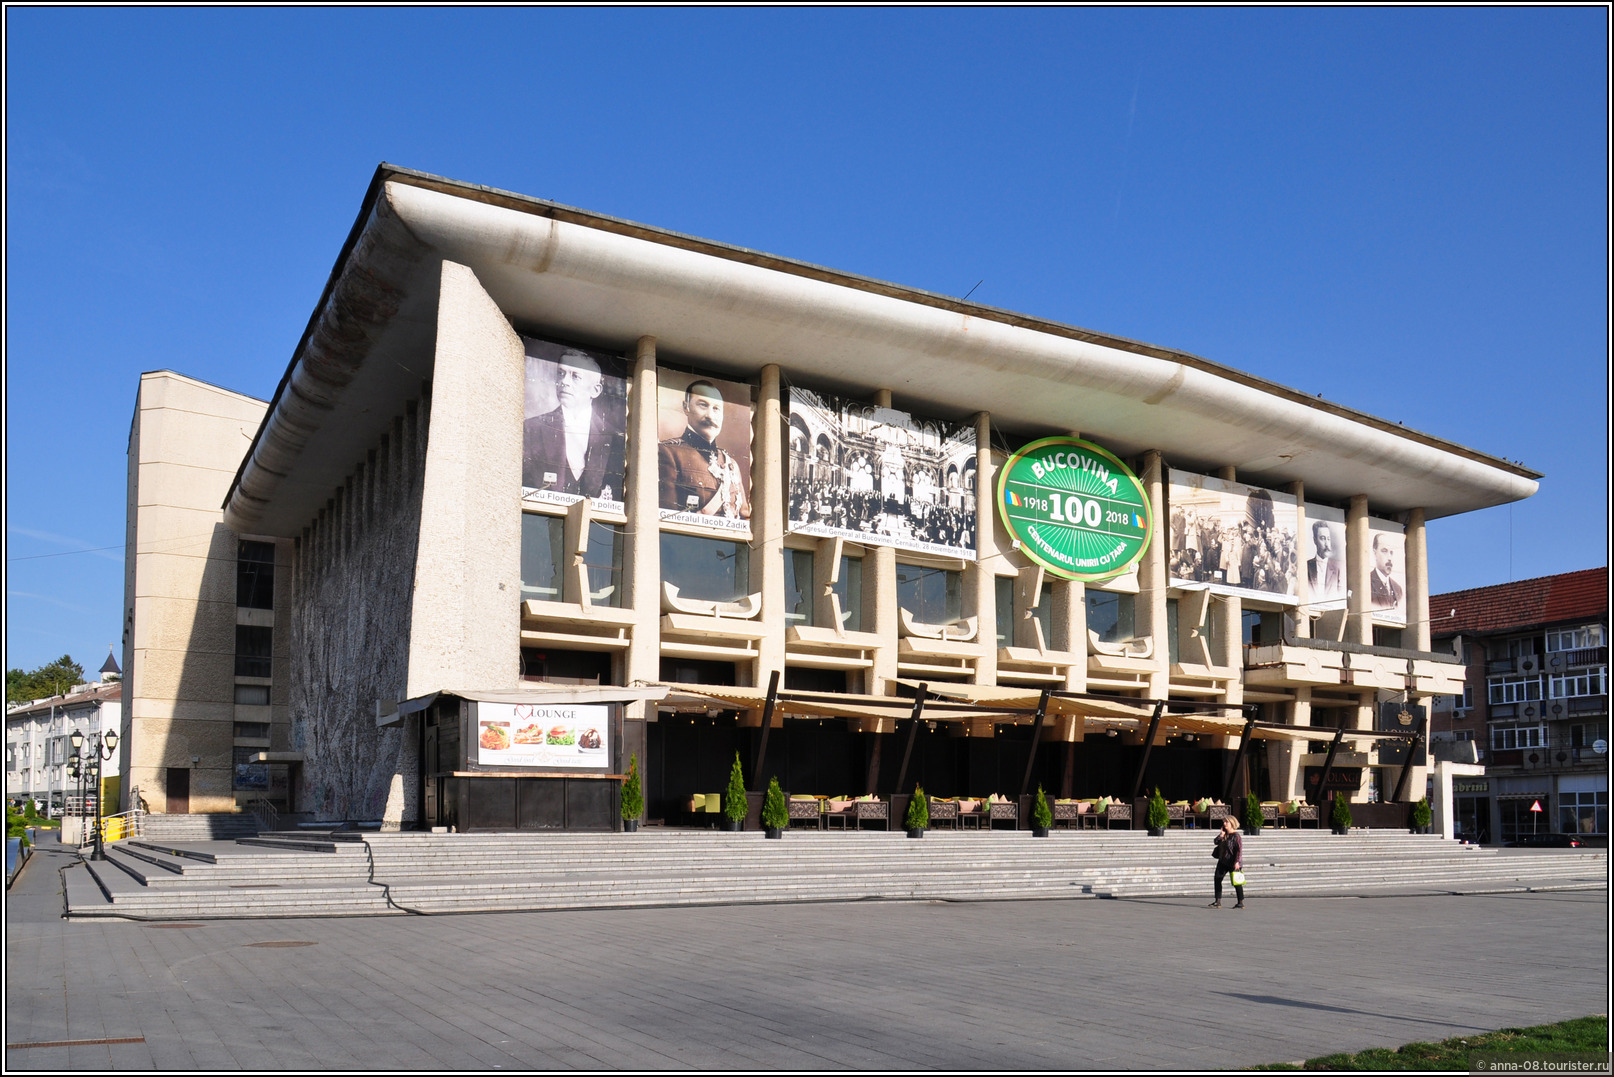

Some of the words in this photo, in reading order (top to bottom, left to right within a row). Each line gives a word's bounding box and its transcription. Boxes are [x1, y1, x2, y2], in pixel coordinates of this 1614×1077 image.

[1032, 453, 1118, 494] BUCOVINA
[522, 489, 545, 499] Iancu
[597, 502, 622, 511] politic
[1024, 497, 1048, 512] 1918
[1049, 493, 1102, 527] 100
[1106, 511, 1129, 526] 2018
[659, 510, 700, 523] Generalul
[702, 517, 724, 527] Iacob
[725, 520, 748, 530] Zadik
[793, 522, 828, 535] Congresul
[828, 529, 854, 538] General
[930, 544, 959, 555] noiembrie
[959, 549, 973, 557] 1918
[1028, 526, 1074, 566] CENTENARUL
[1076, 557, 1099, 567] UNIRII
[1100, 555, 1110, 565] CU
[531, 709, 576, 719] LOUNGE
